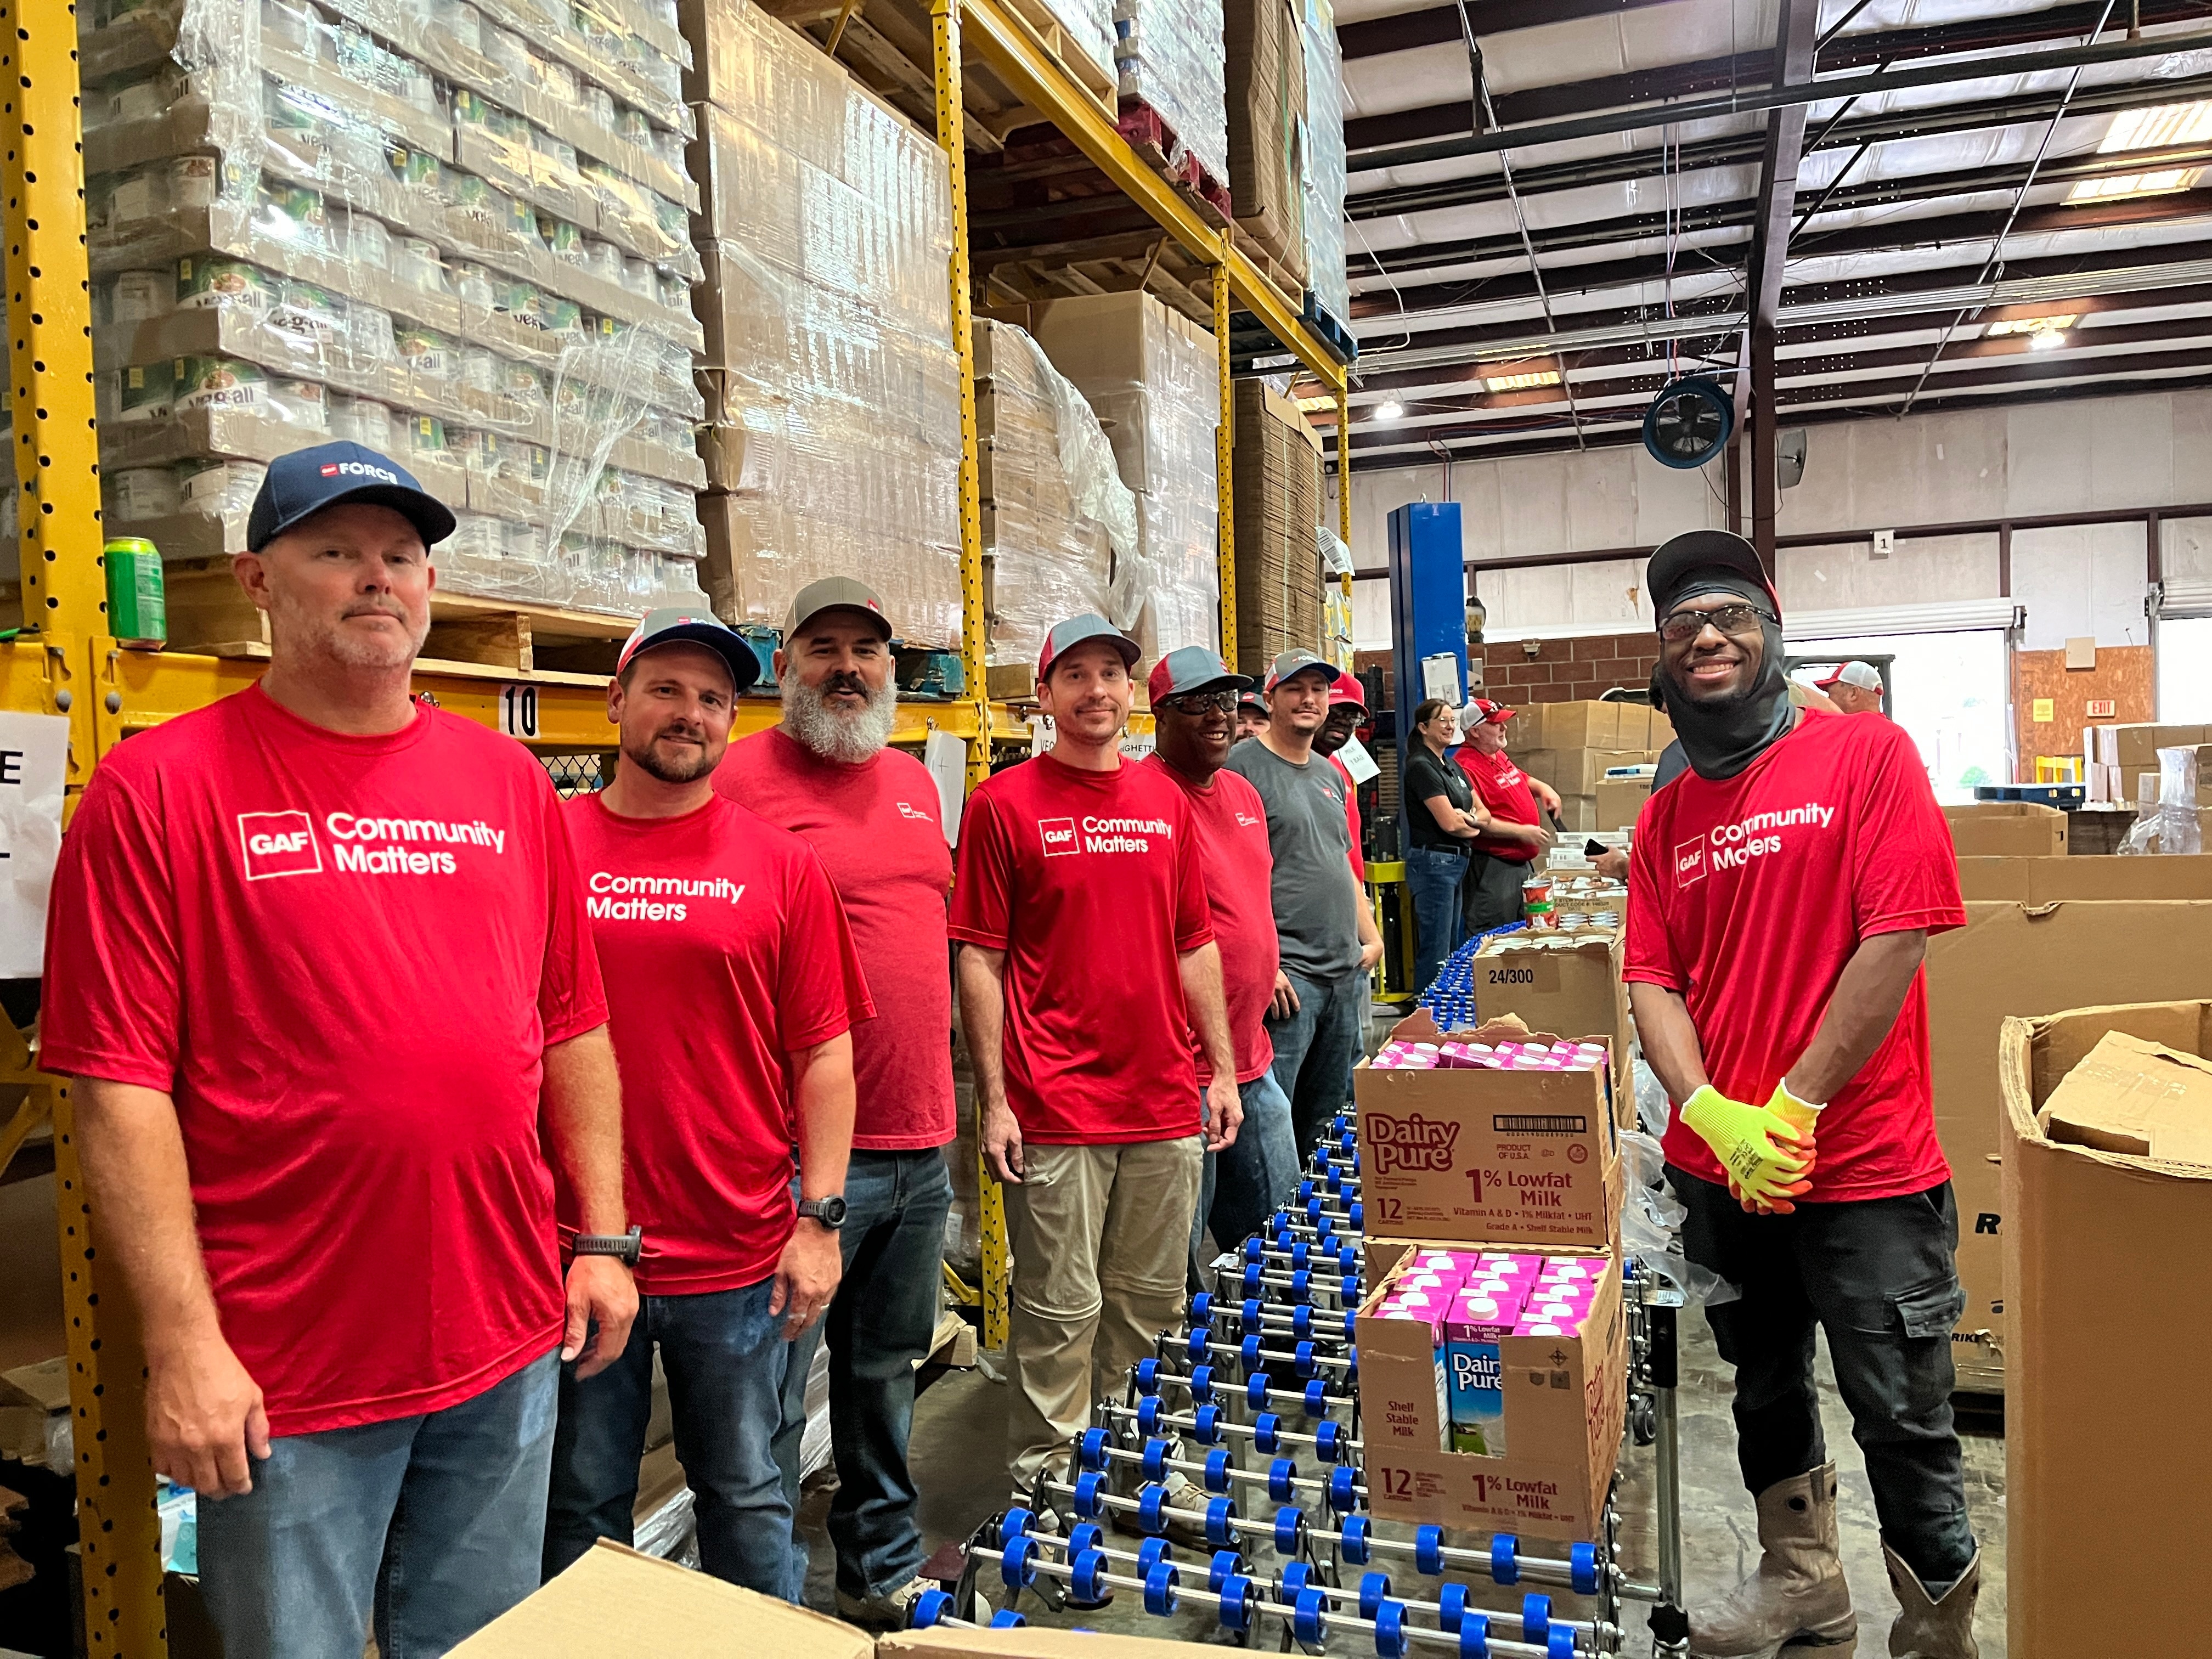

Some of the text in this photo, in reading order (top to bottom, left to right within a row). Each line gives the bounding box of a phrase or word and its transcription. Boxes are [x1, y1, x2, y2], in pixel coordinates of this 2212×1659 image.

[1880, 538, 1888, 549] 1
[505, 685, 536, 737] 10
[2092, 701, 2111, 714] EXIT
[326, 812, 505, 854] Community
[1082, 816, 1172, 840] Community
[1710, 802, 1835, 847] Community
[250, 831, 308, 855] GAF
[1045, 830, 1073, 843] GAF
[1085, 835, 1149, 854] Matters
[332, 844, 457, 874] Matters
[1679, 849, 1702, 872] GAF
[1712, 835, 1781, 872] Maers
[589, 871, 746, 905] Community
[586, 896, 687, 922] Matters
[1489, 968, 1533, 984] 24/300
[1366, 1114, 1460, 1148] Dairy
[1375, 1144, 1452, 1173] Pure
[1465, 1169, 1573, 1203] 1% Lowfat
[1377, 1198, 1403, 1220] 12
[1520, 1189, 1562, 1207] Milk
[1453, 1207, 1486, 1216] Vitamin
[1488, 1208, 1495, 1217] A
[1497, 1209, 1504, 1217] &
[1505, 1209, 1512, 1217] D
[1521, 1210, 1533, 1219] 1%
[1535, 1210, 1565, 1220] Milkfat
[1575, 1212, 1592, 1221] UHT
[1486, 1222, 1510, 1231] Grade
[1527, 1224, 1547, 1232] Shelf
[1549, 1225, 1575, 1233] Stable
[1577, 1226, 1594, 1234] Milk
[1463, 1325, 1478, 1338] 1%
[1453, 1353, 1500, 1374] Dair
[1388, 1401, 1414, 1412] Shelf
[1386, 1413, 1419, 1425] Stable
[1392, 1426, 1414, 1437] Milk
[1381, 1468, 1413, 1496] 12
[1472, 1474, 1502, 1502] 1%
[1506, 1477, 1558, 1496] Lowfat
[1516, 1494, 1550, 1510] Milk
